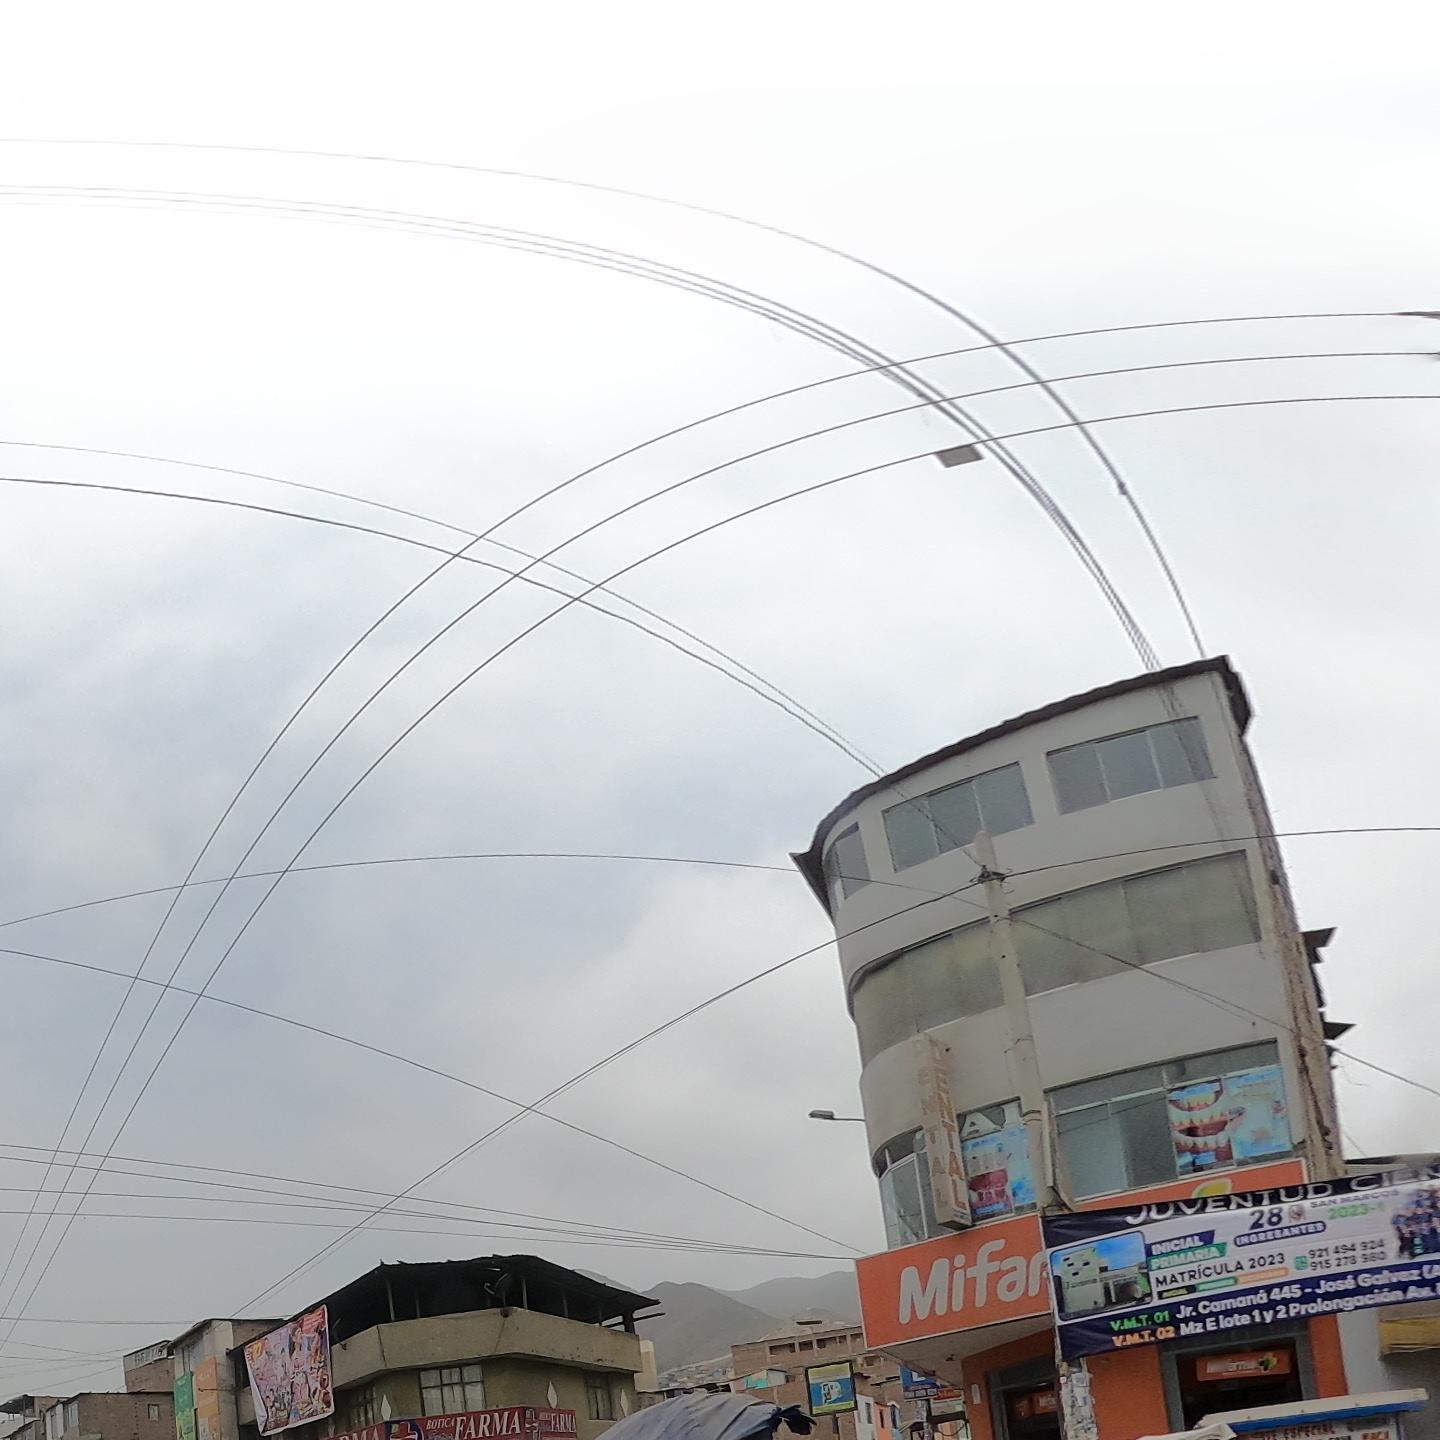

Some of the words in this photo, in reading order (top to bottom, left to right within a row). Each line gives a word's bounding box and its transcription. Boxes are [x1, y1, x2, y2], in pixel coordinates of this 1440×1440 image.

[1125, 1181, 1333, 1226] JUVENTUD
[1250, 1207, 1283, 1230] 28
[1151, 1234, 1204, 1256] INICIAL
[1235, 1222, 1325, 1246] INGRESANTES
[1150, 1245, 1222, 1270] PRIMARIA
[1308, 1246, 1330, 1259] 921
[1333, 1243, 1356, 1256] 494
[1360, 1238, 1385, 1250] 924
[1155, 1262, 1244, 1288] MATRÍCULA
[1248, 1253, 1286, 1269] 2023
[1310, 1258, 1331, 1271] 915
[897, 1236, 1049, 1325] Mifar
[1110, 1314, 1152, 1332] V.M.T.
[1153, 1310, 1171, 1323] 01
[1176, 1305, 1198, 1320] Jr.
[1198, 1290, 1268, 1316] Camaná
[1269, 1284, 1302, 1302] 445
[1315, 1276, 1357, 1295] José
[1156, 1326, 1176, 1340] 02
[1180, 1320, 1205, 1336] Mz
[1205, 1316, 1217, 1332] E
[1218, 1312, 1250, 1331] lote
[1252, 1308, 1262, 1323] 1
[1263, 1310, 1274, 1325] y
[1276, 1306, 1288, 1320] 2
[1288, 1281, 1405, 1317] Prolongación
[426, 1417, 456, 1430] BOTICA
[454, 1408, 522, 1440] FARMA
[550, 1411, 577, 1434] FARMA
